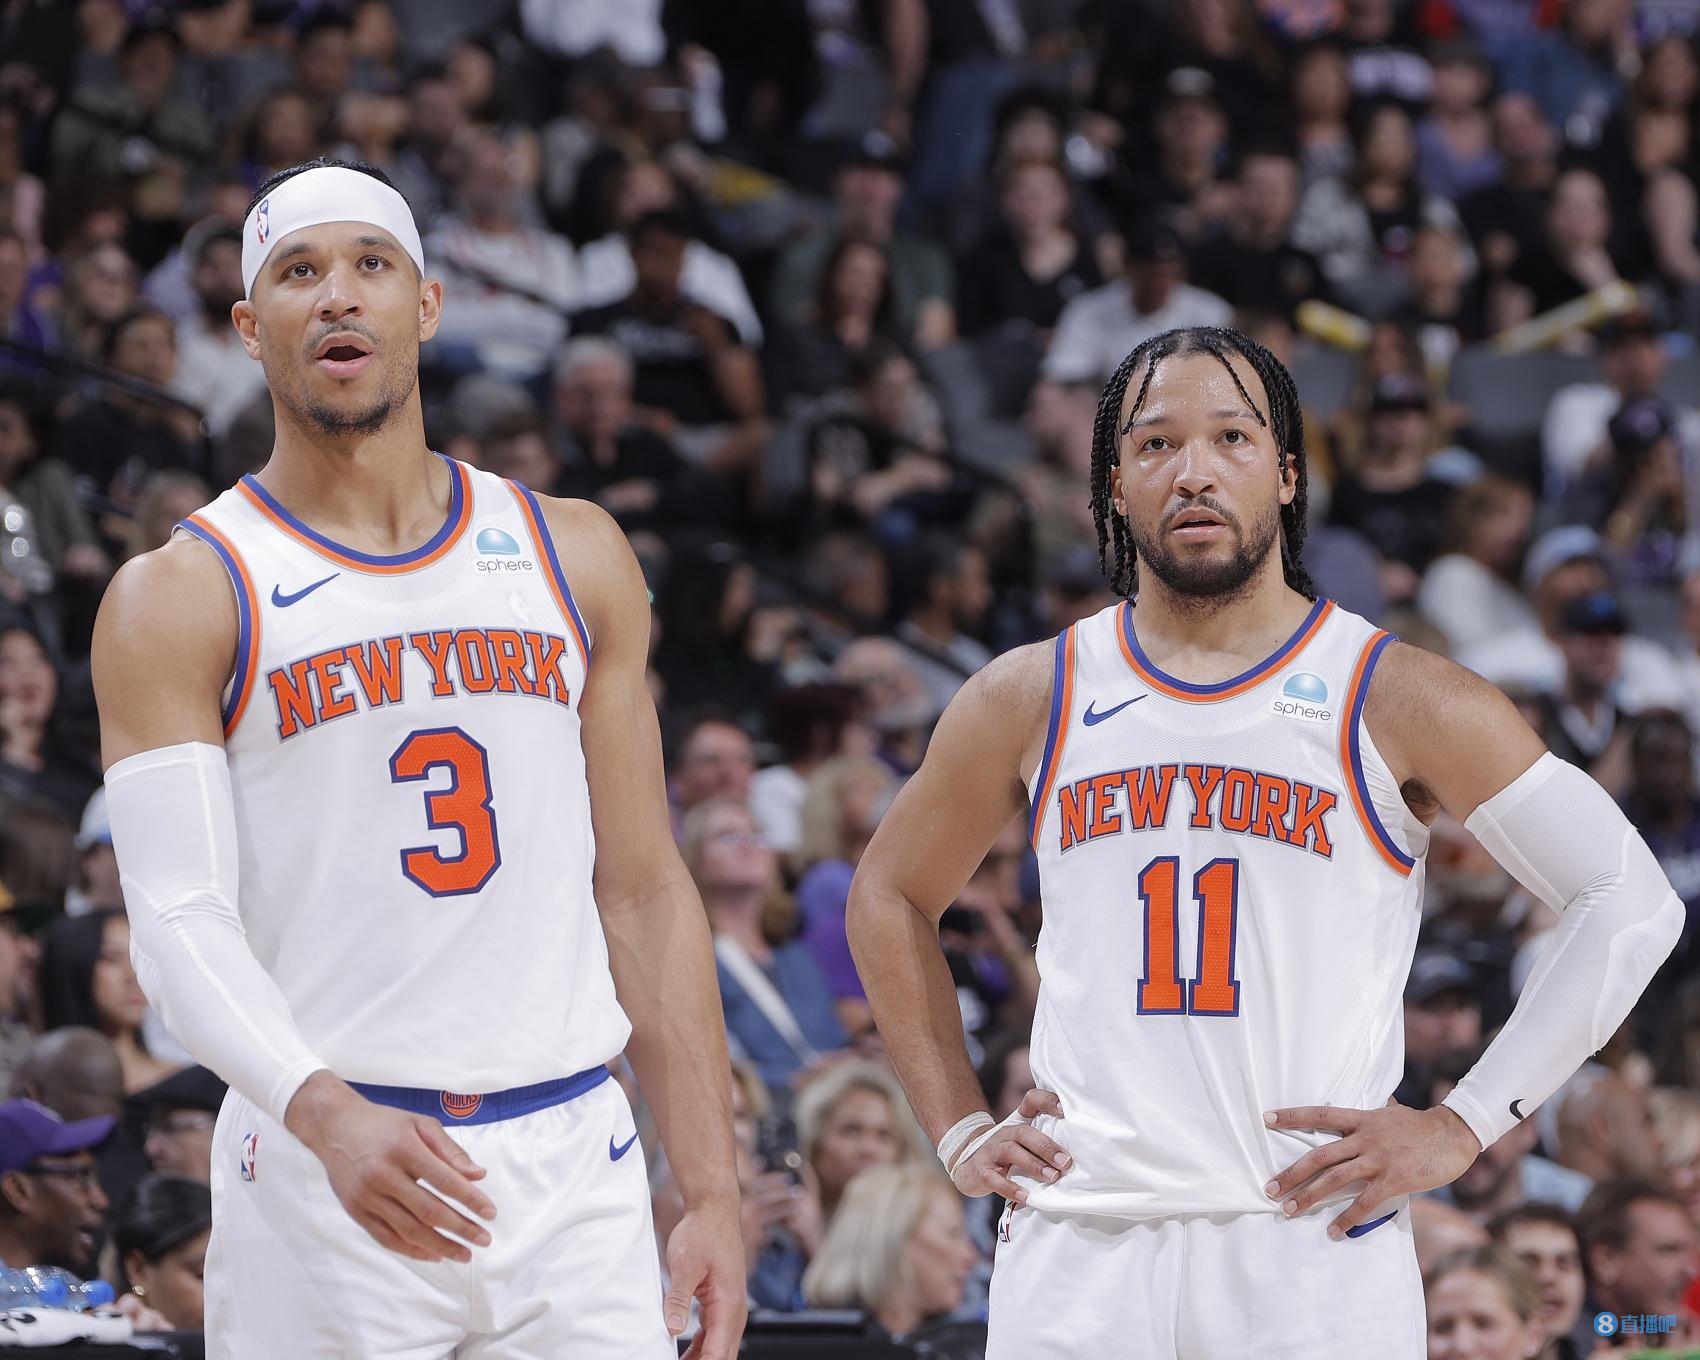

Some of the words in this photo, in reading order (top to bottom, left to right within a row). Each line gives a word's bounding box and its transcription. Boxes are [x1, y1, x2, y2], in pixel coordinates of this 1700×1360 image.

[476, 558, 532, 573] sphere
[266, 633, 404, 742] NEW
[411, 627, 570, 709] YORK
[1273, 701, 1331, 721] sphere
[388, 726, 502, 898] 3
[1057, 762, 1181, 855] NEW
[1181, 761, 1341, 861] YORK
[1136, 855, 1241, 1017] 11
